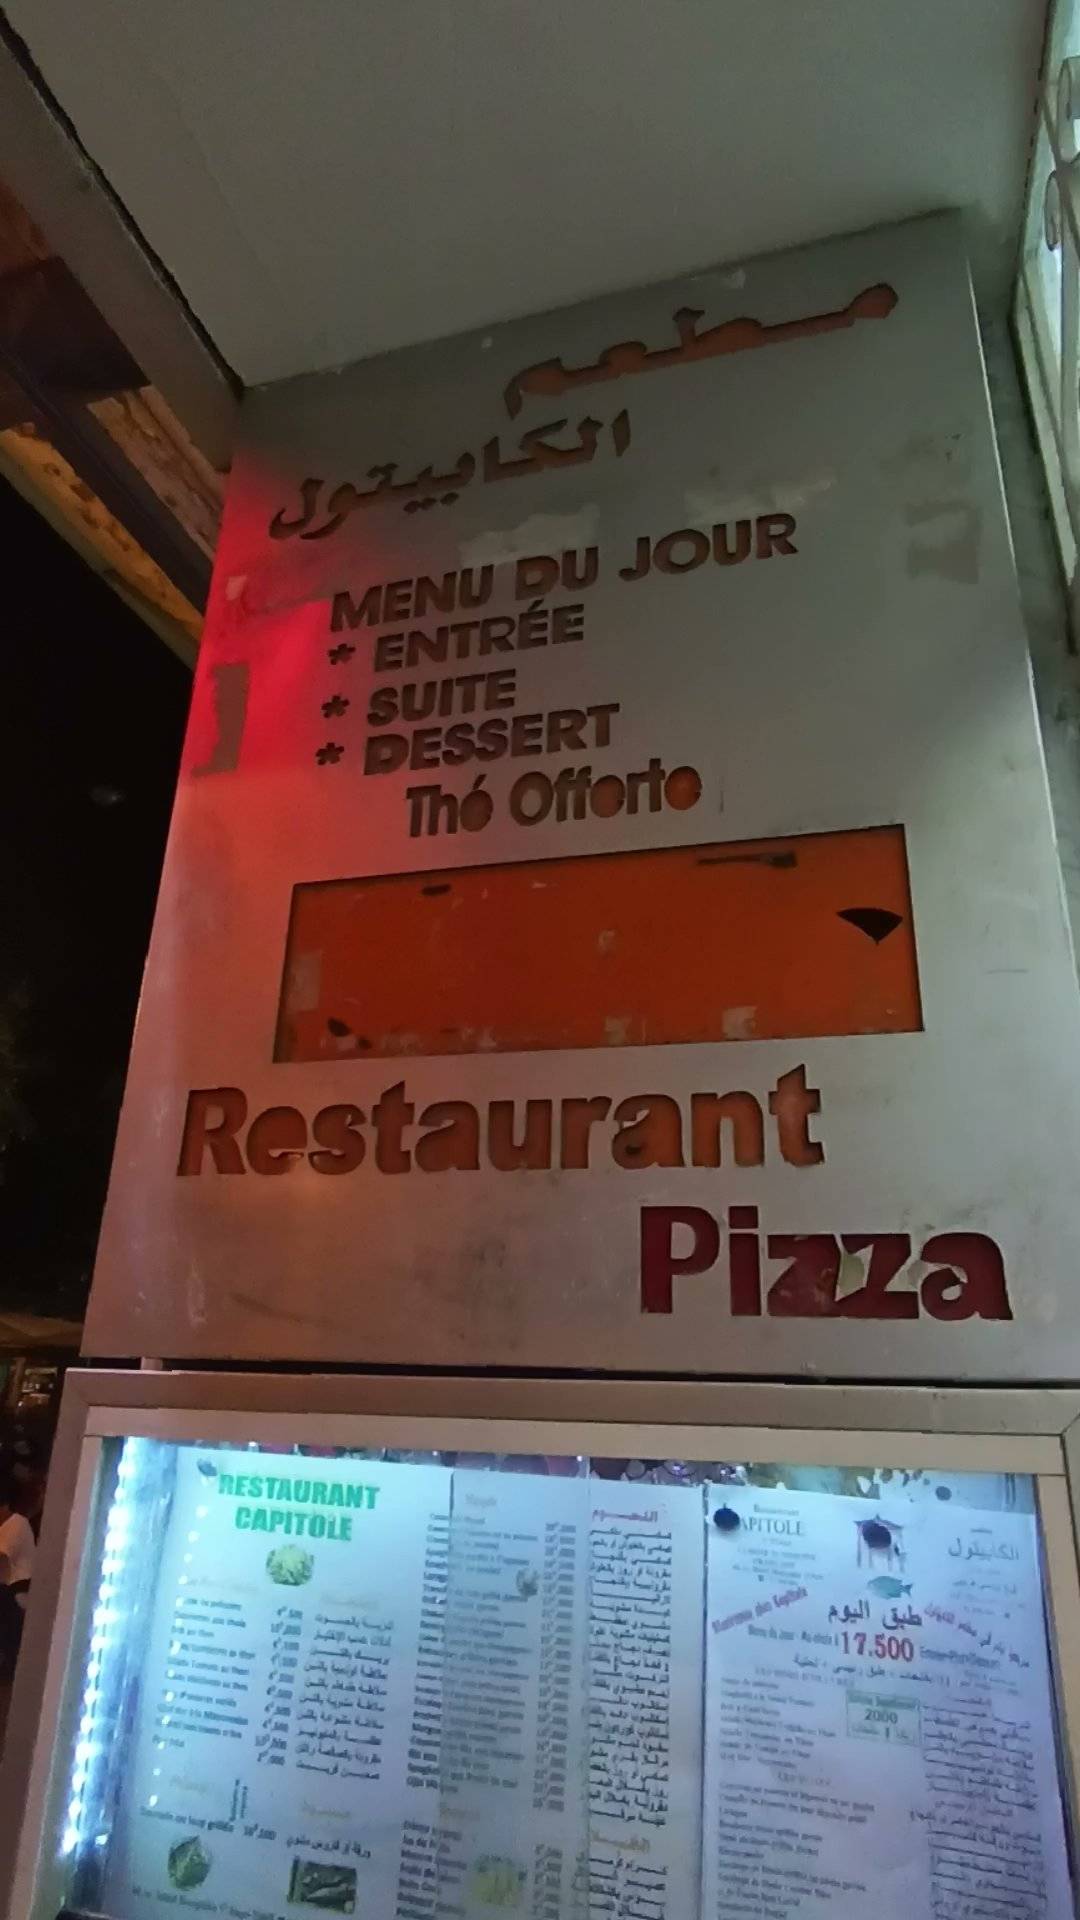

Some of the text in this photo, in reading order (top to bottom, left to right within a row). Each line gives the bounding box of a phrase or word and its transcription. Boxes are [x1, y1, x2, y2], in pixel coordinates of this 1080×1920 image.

[503, 282, 898, 419] مطعم
[268, 409, 631, 541] الكابيتول
[329, 512, 798, 633] MENU DU JOUR
[373, 600, 586, 672] ENTRÉE
[366, 669, 517, 727] SUITE
[363, 703, 620, 776] DESSERT
[176, 1064, 826, 1177] Restaurant
[640, 1205, 1014, 1322] Pizza
[218, 1474, 381, 1509] RESTAURANT
[235, 1507, 352, 1541] CAPITOLE
[738, 1517, 805, 1536] APITOLE
[828, 1599, 870, 1624] اليوم
[882, 1604, 922, 1630] طبق
[841, 1631, 914, 1663] 17.500
